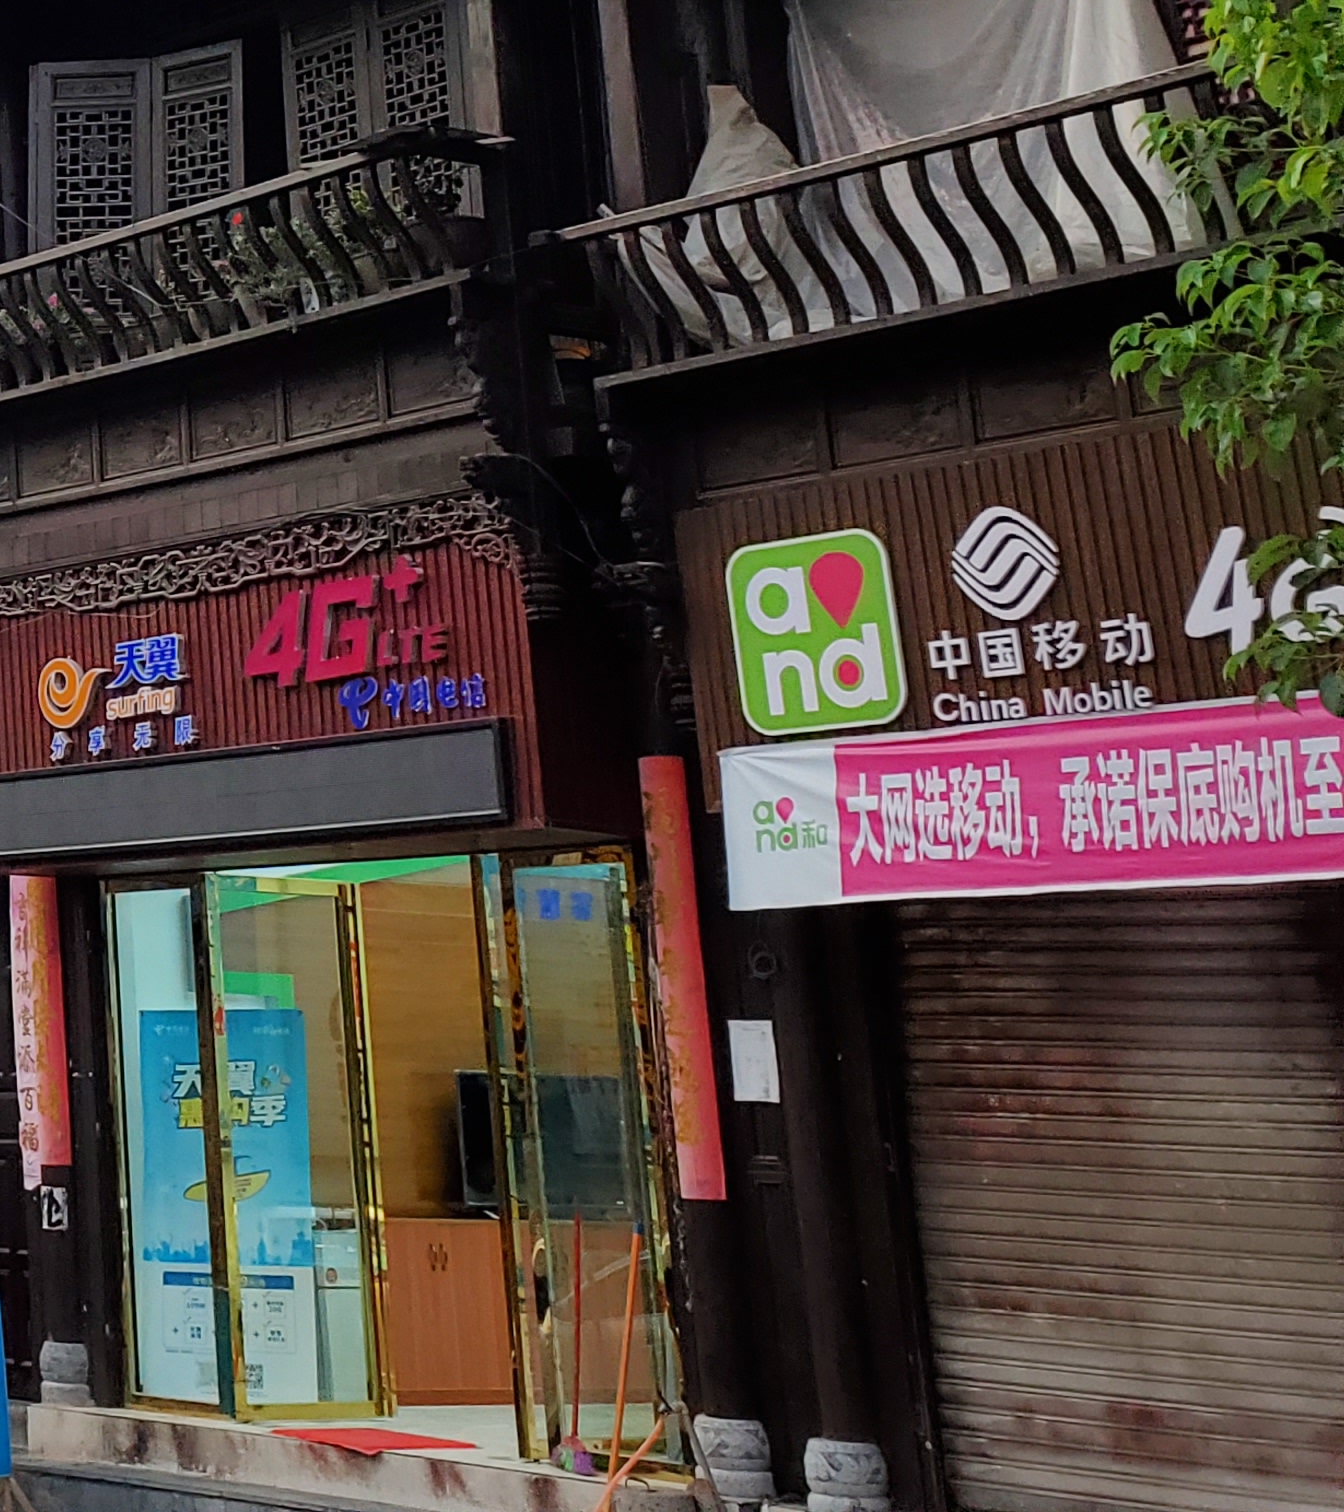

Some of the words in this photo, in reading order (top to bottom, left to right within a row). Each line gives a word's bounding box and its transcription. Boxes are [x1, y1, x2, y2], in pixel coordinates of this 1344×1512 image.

[105, 633, 190, 690] 天翼
[377, 622, 448, 667] LTE
[927, 613, 1156, 680] 中国移动
[106, 686, 176, 720] surfing
[382, 673, 487, 719] 中国电信
[933, 691, 1027, 722] China
[1042, 680, 1153, 716] Mobile
[50, 715, 196, 762] 分享无限
